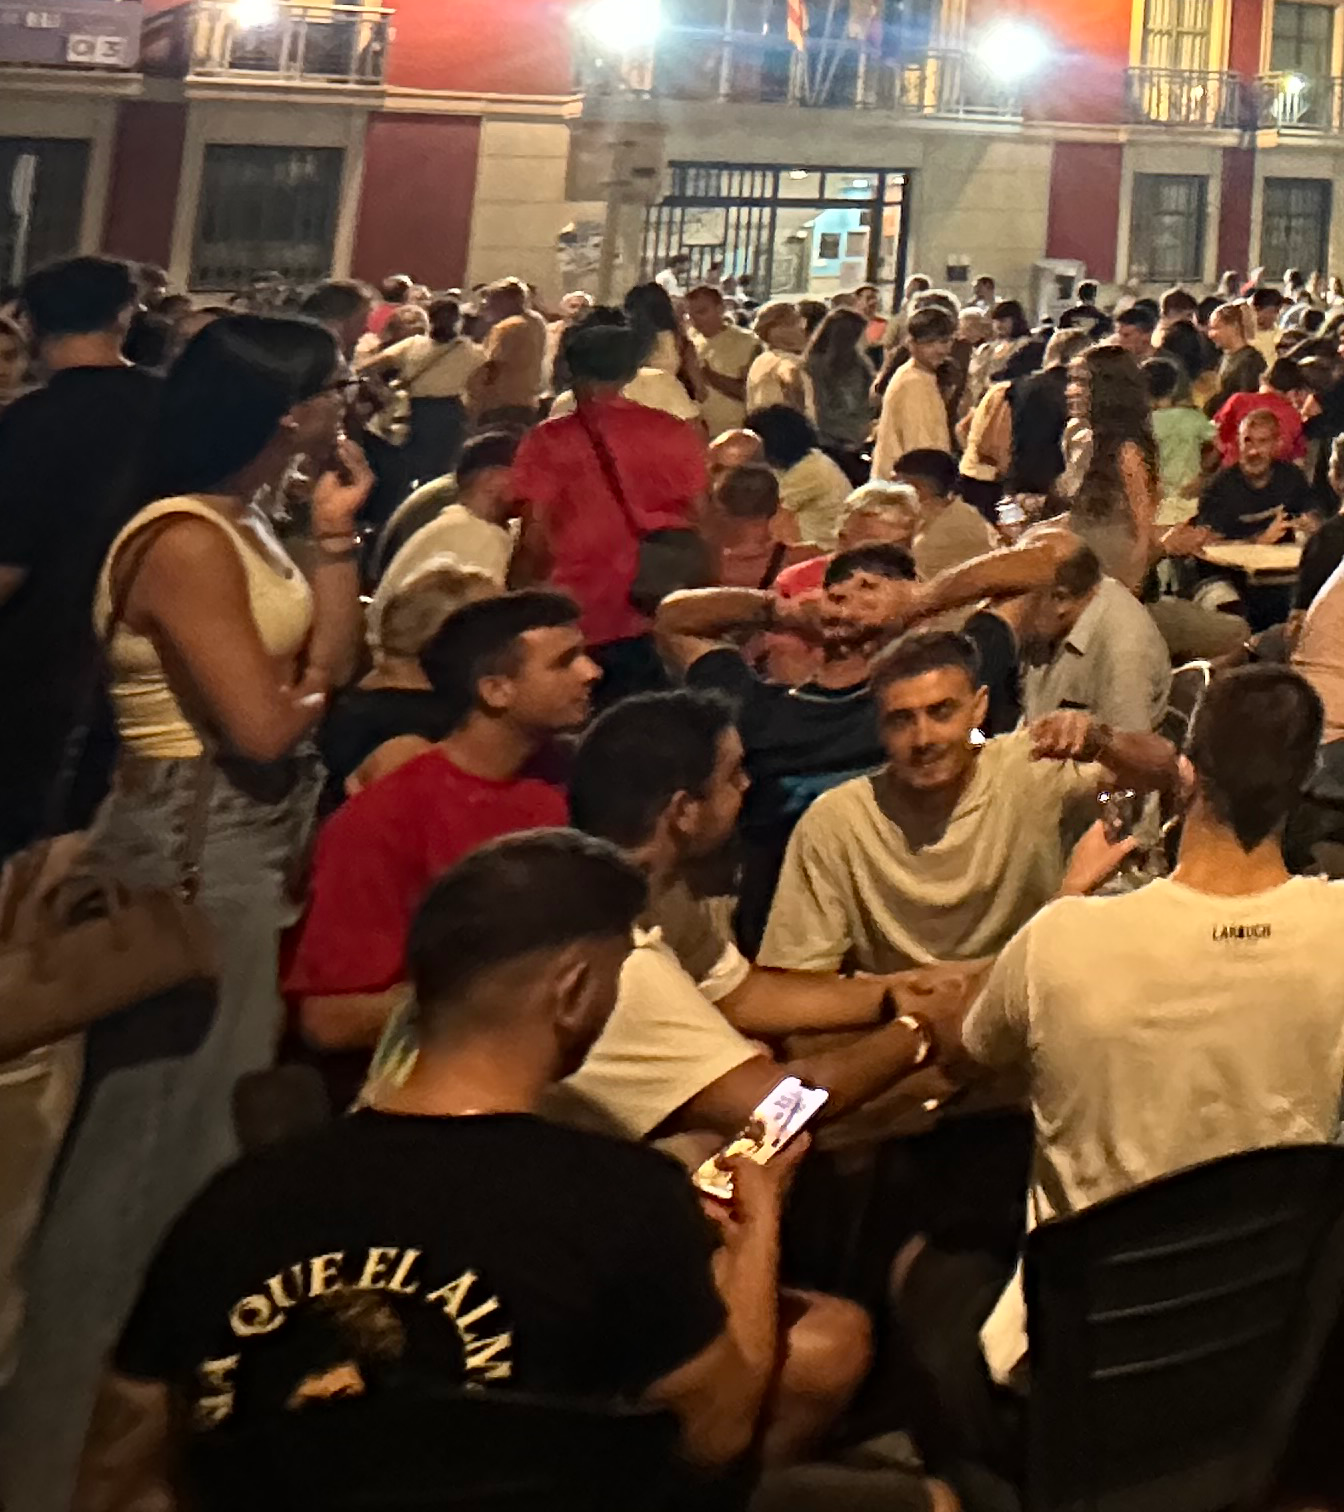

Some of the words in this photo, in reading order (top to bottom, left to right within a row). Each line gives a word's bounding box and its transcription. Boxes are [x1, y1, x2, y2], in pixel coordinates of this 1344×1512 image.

[229, 1250, 346, 1337] QUE
[355, 1246, 423, 1294] EL
[424, 1267, 515, 1392] ALM
